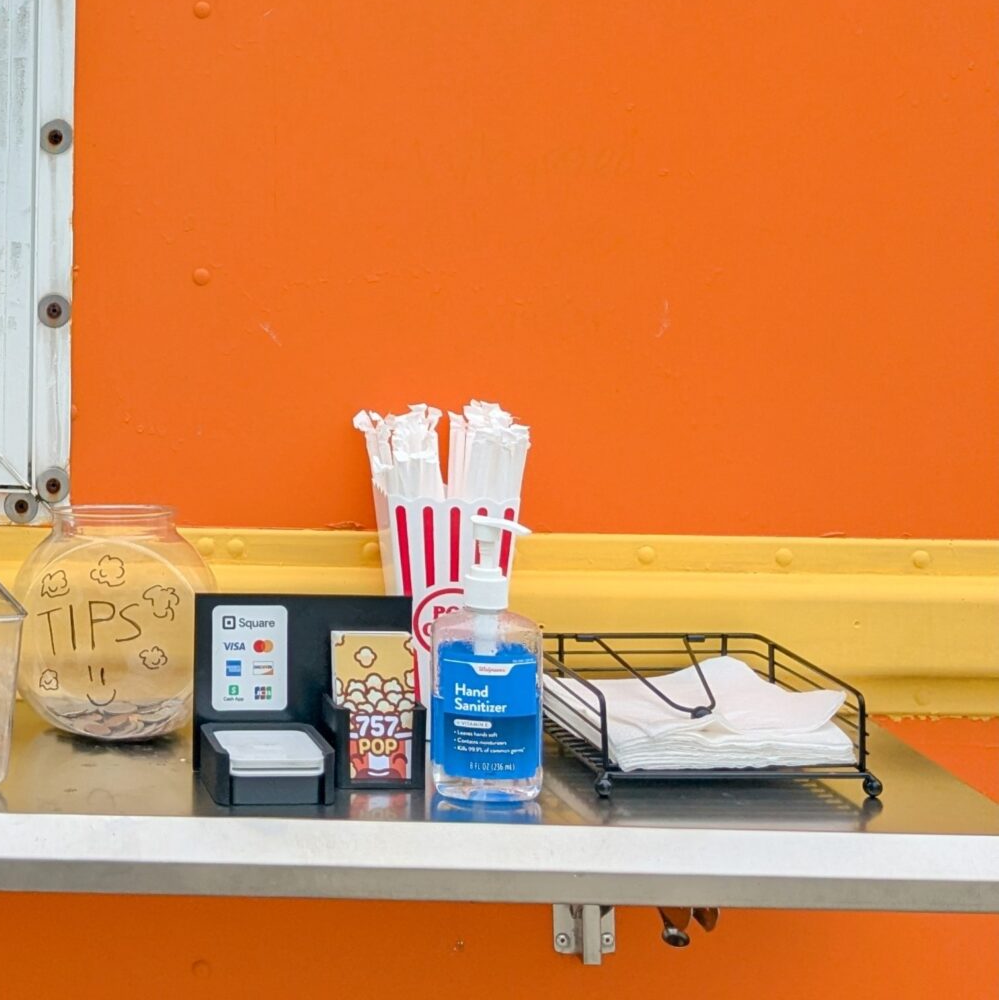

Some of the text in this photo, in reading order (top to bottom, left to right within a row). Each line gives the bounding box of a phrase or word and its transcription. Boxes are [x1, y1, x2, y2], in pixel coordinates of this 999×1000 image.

[37, 600, 142, 656] TIPS
[238, 617, 276, 630] Square
[223, 642, 246, 651] VISA
[454, 682, 489, 698] Hand
[454, 697, 507, 713] Sanitizer
[355, 714, 399, 737] 757
[359, 738, 398, 755] POP
